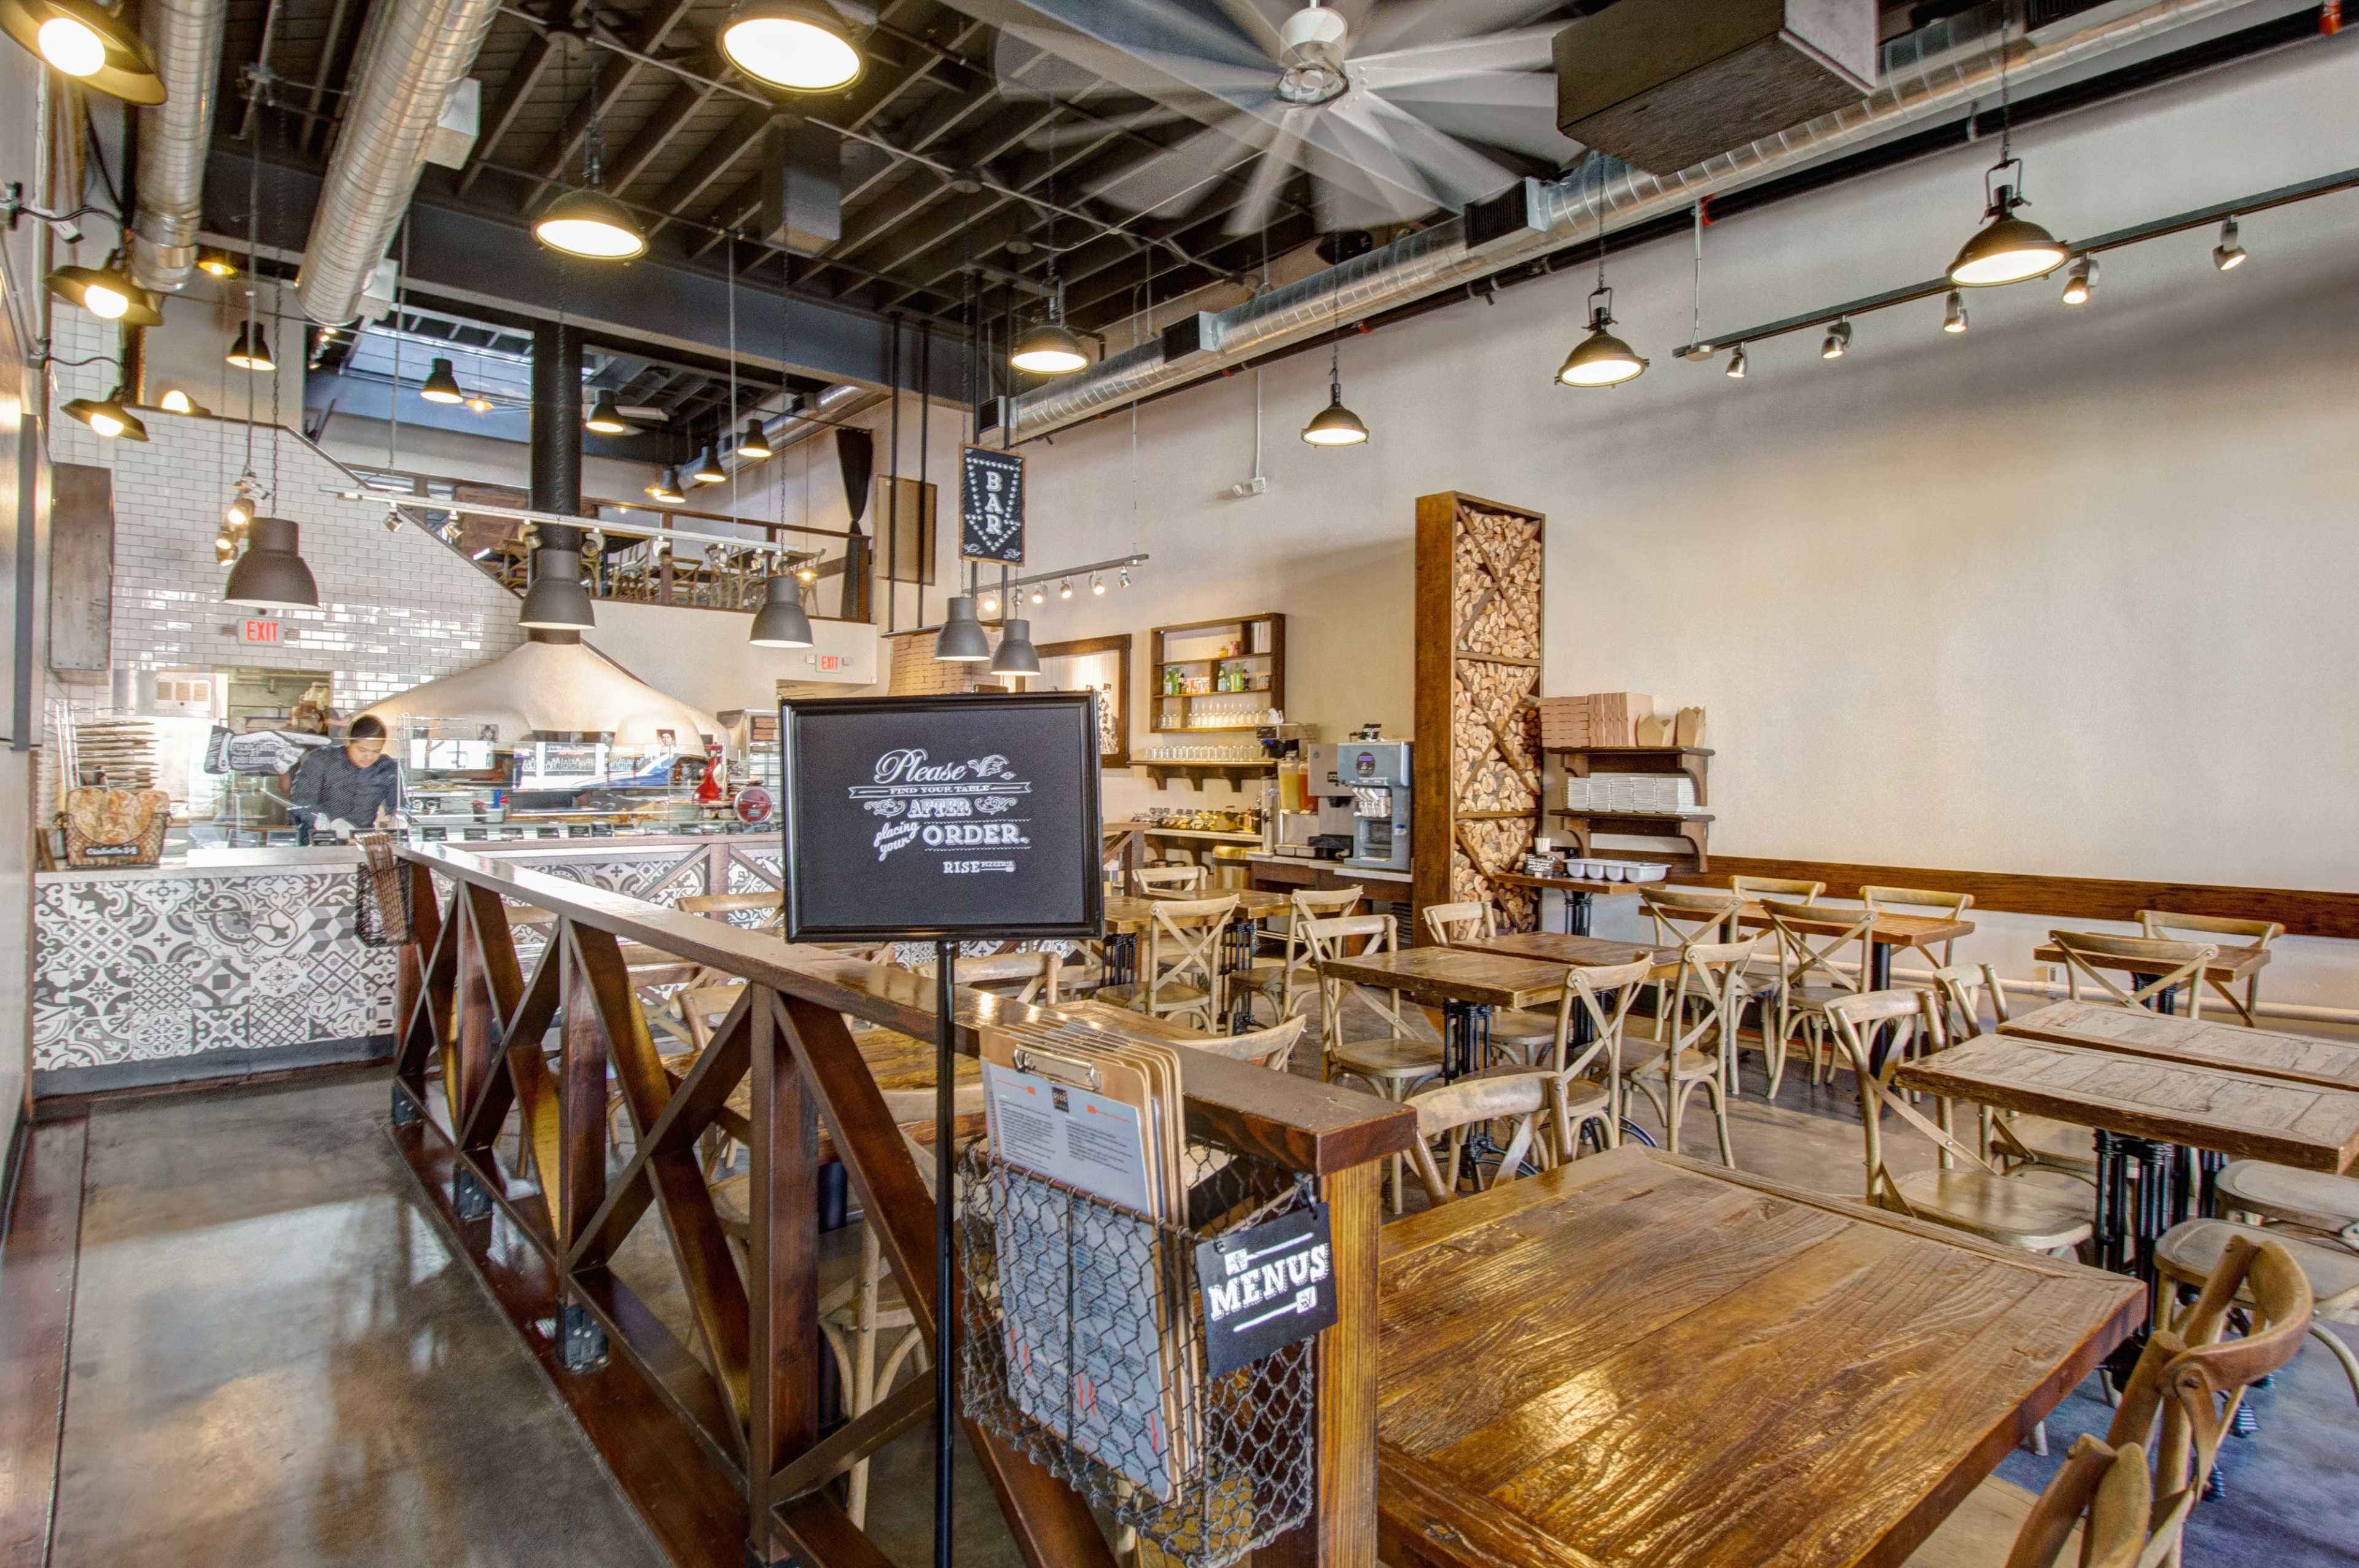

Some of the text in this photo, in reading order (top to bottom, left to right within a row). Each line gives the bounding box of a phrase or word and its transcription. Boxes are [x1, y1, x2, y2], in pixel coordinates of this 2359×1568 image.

[985, 470, 1004, 536] BAR
[246, 620, 280, 642] EXIT
[821, 655, 839, 669] EXIT
[874, 749, 968, 784] Please
[907, 798, 973, 818] AFTER
[873, 821, 921, 847] placing
[878, 837, 912, 861] your
[943, 861, 980, 873] RISE
[1208, 1243, 1330, 1321] MENUS
